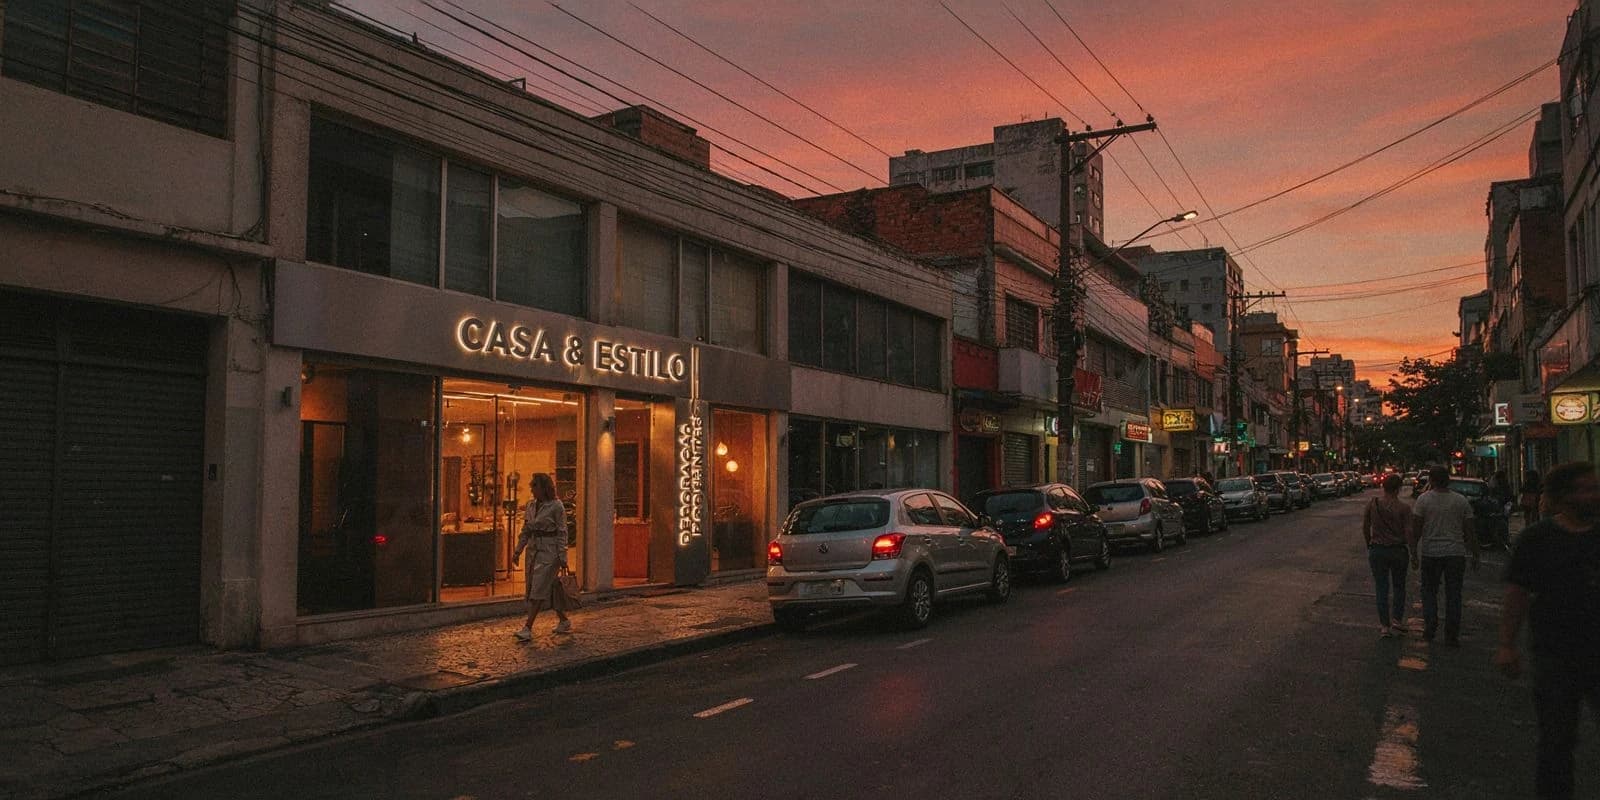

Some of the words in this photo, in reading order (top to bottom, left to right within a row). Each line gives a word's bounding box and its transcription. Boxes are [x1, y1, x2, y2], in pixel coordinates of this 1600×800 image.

[457, 316, 556, 363] CASA
[563, 334, 585, 366] &
[593, 340, 688, 382] ESTILO
